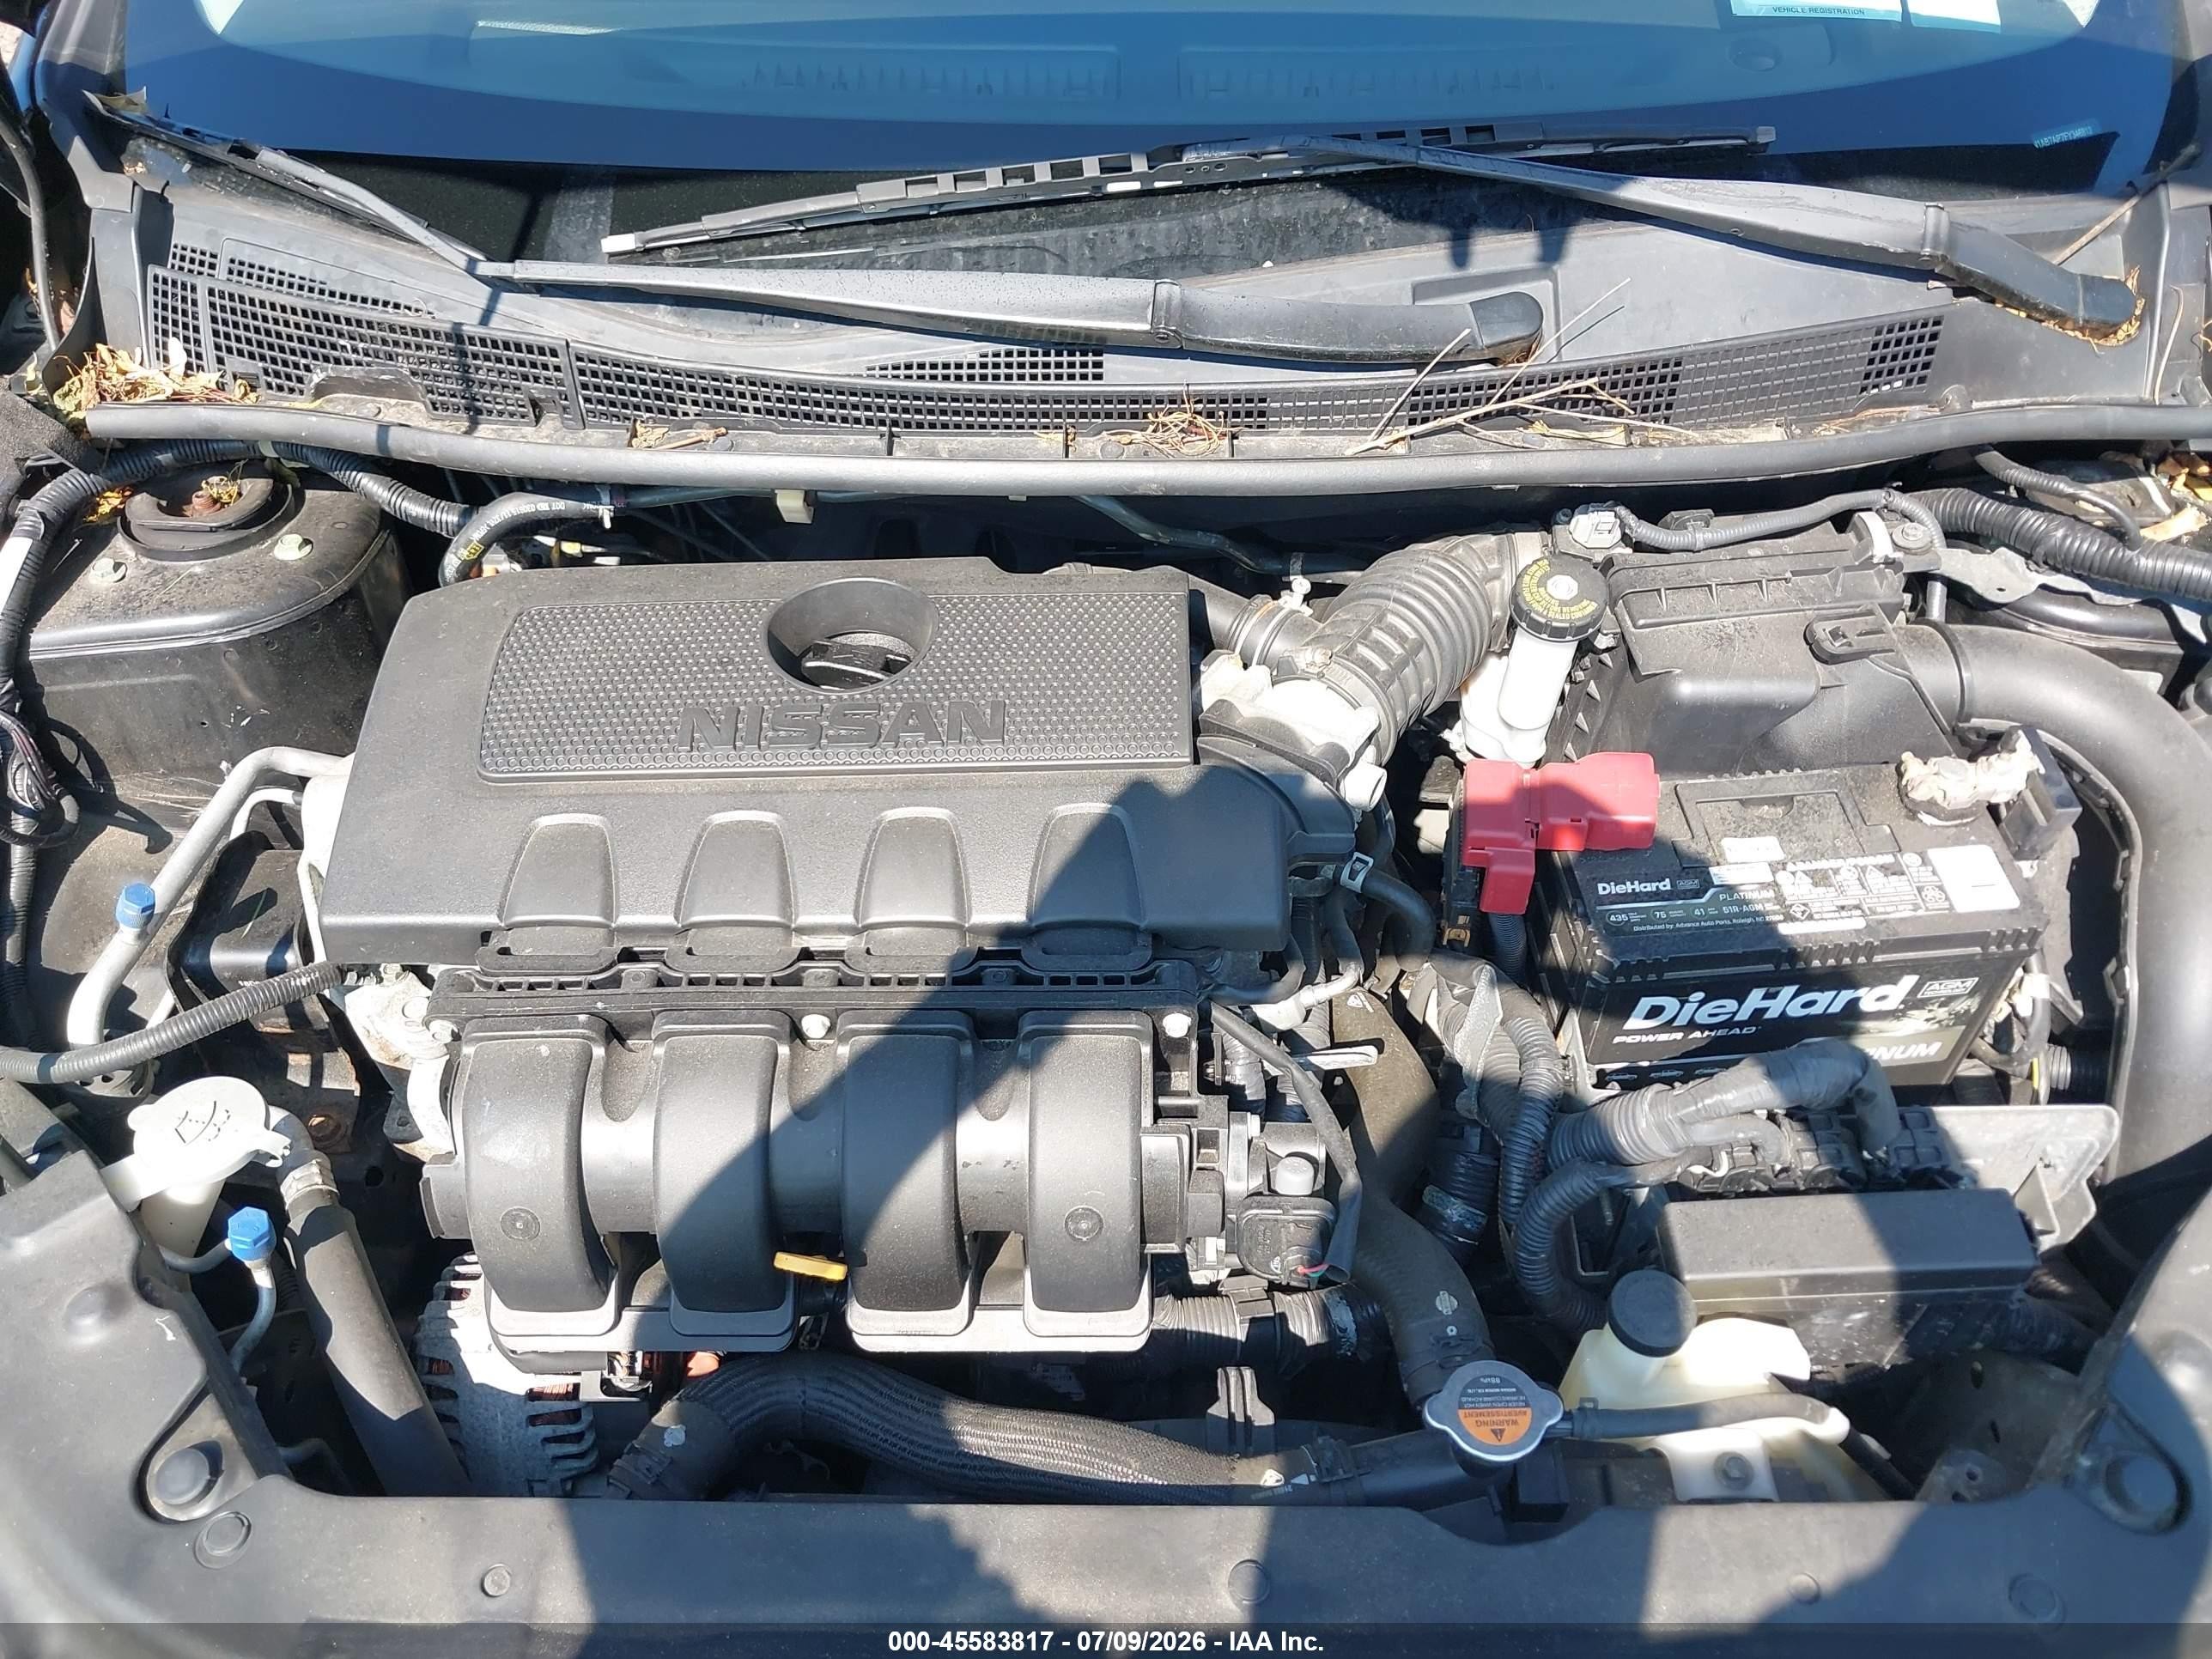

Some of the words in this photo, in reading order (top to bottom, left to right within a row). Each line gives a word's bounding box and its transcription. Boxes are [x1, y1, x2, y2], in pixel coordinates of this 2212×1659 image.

[1808, 7, 1865, 15] REGISTRATION
[678, 700, 1006, 752] NISSAN
[1597, 878, 1671, 895] DieHard
[1719, 890, 1775, 902] PLATINUM
[1694, 908, 1705, 916] 41
[1609, 913, 1628, 922] 435
[1633, 923, 1665, 932] Distributed
[1926, 980, 1973, 991] AGM
[1622, 975, 1920, 1030] DieHard
[1613, 1032, 1685, 1045] POWER
[1687, 1026, 1757, 1039] AHEAD
[1463, 1409, 1527, 1419] AVERTISSEMENT
[1475, 1419, 1520, 1428] WARNING
